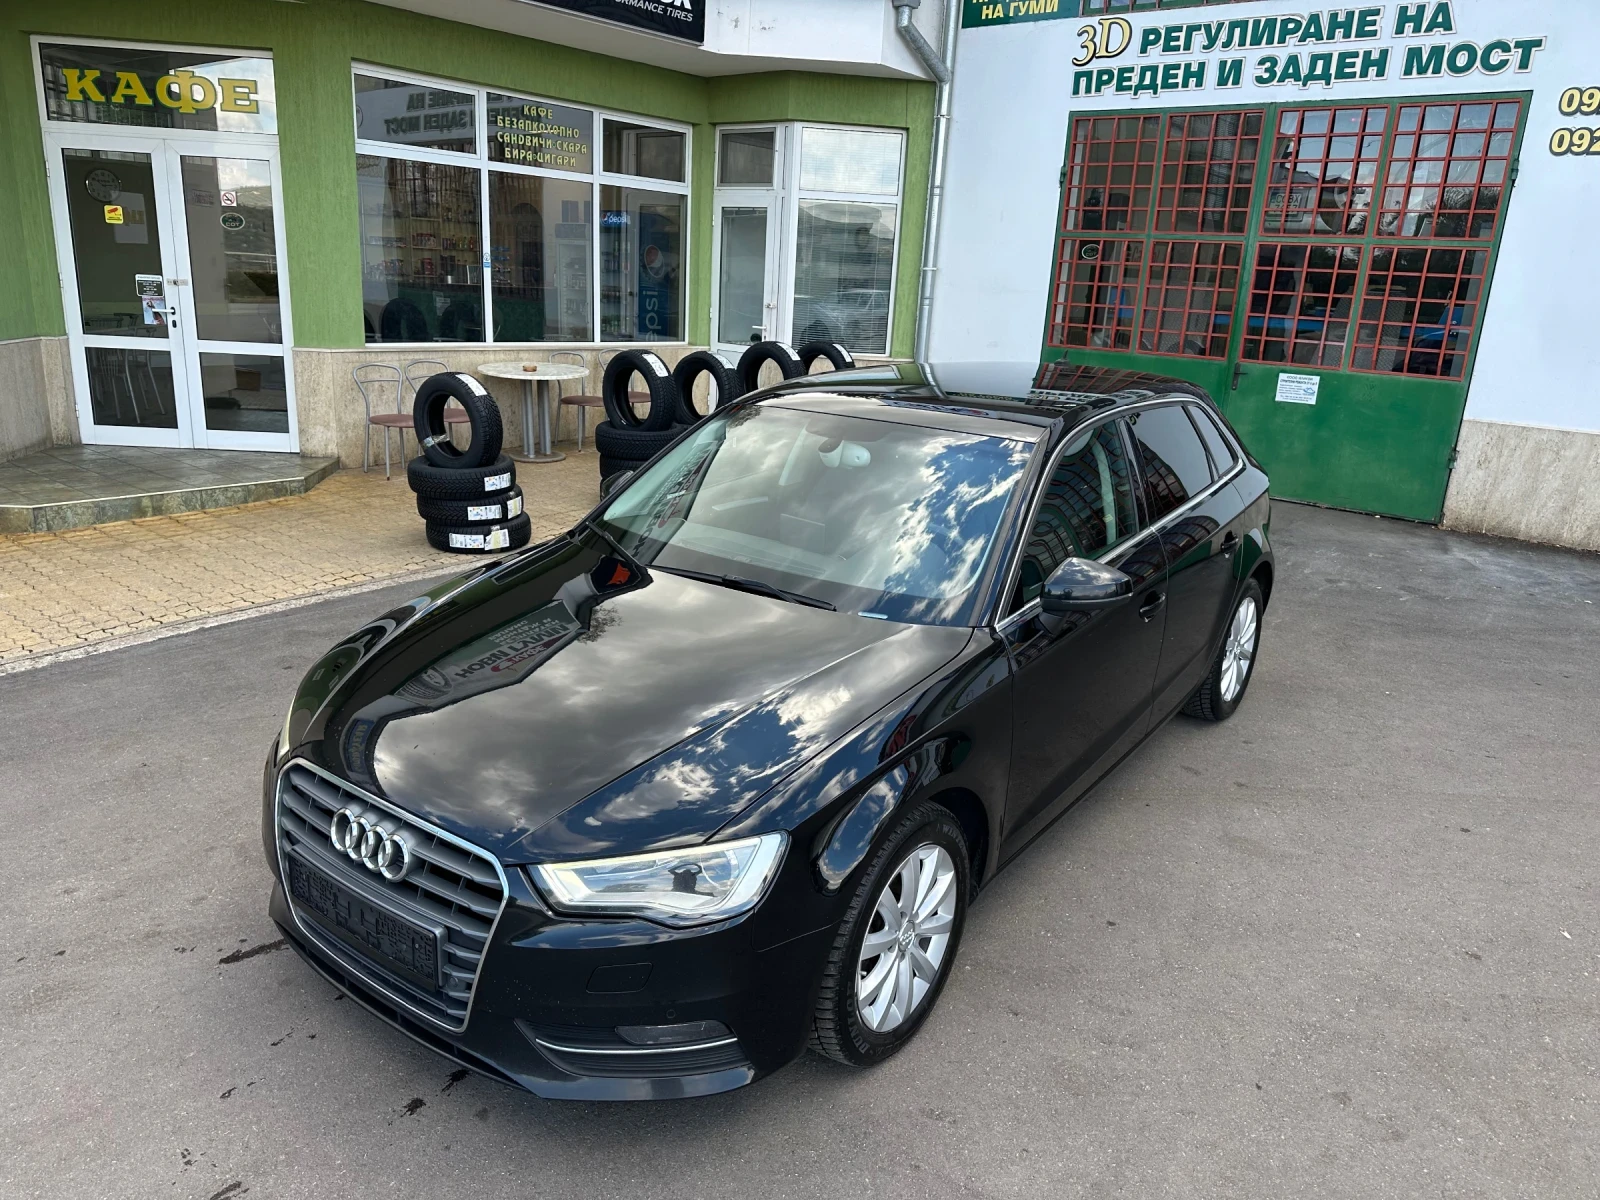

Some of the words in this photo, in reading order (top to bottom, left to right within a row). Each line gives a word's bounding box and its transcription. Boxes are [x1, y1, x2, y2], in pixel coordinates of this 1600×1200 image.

[666, 7, 694, 22] TIRES
[981, 5, 1005, 20] НА
[1009, 0, 1059, 17] ГУМИ
[1071, 17, 1132, 66] 3D
[1138, 7, 1383, 56] РЕГУЛИРАНЕ
[1393, 1, 1455, 37] НА
[1071, 60, 1208, 98] ПРЕДЕН
[1215, 57, 1245, 88] И
[1253, 47, 1391, 88] ЗАДЕН
[1402, 37, 1545, 78] МОСТ
[62, 67, 260, 115] КАФЕ
[523, 105, 553, 119] КАФЕ
[504, 147, 533, 161] БИРА
[537, 153, 576, 167] ЦИГАРИ
[556, 140, 588, 154] СКАРА
